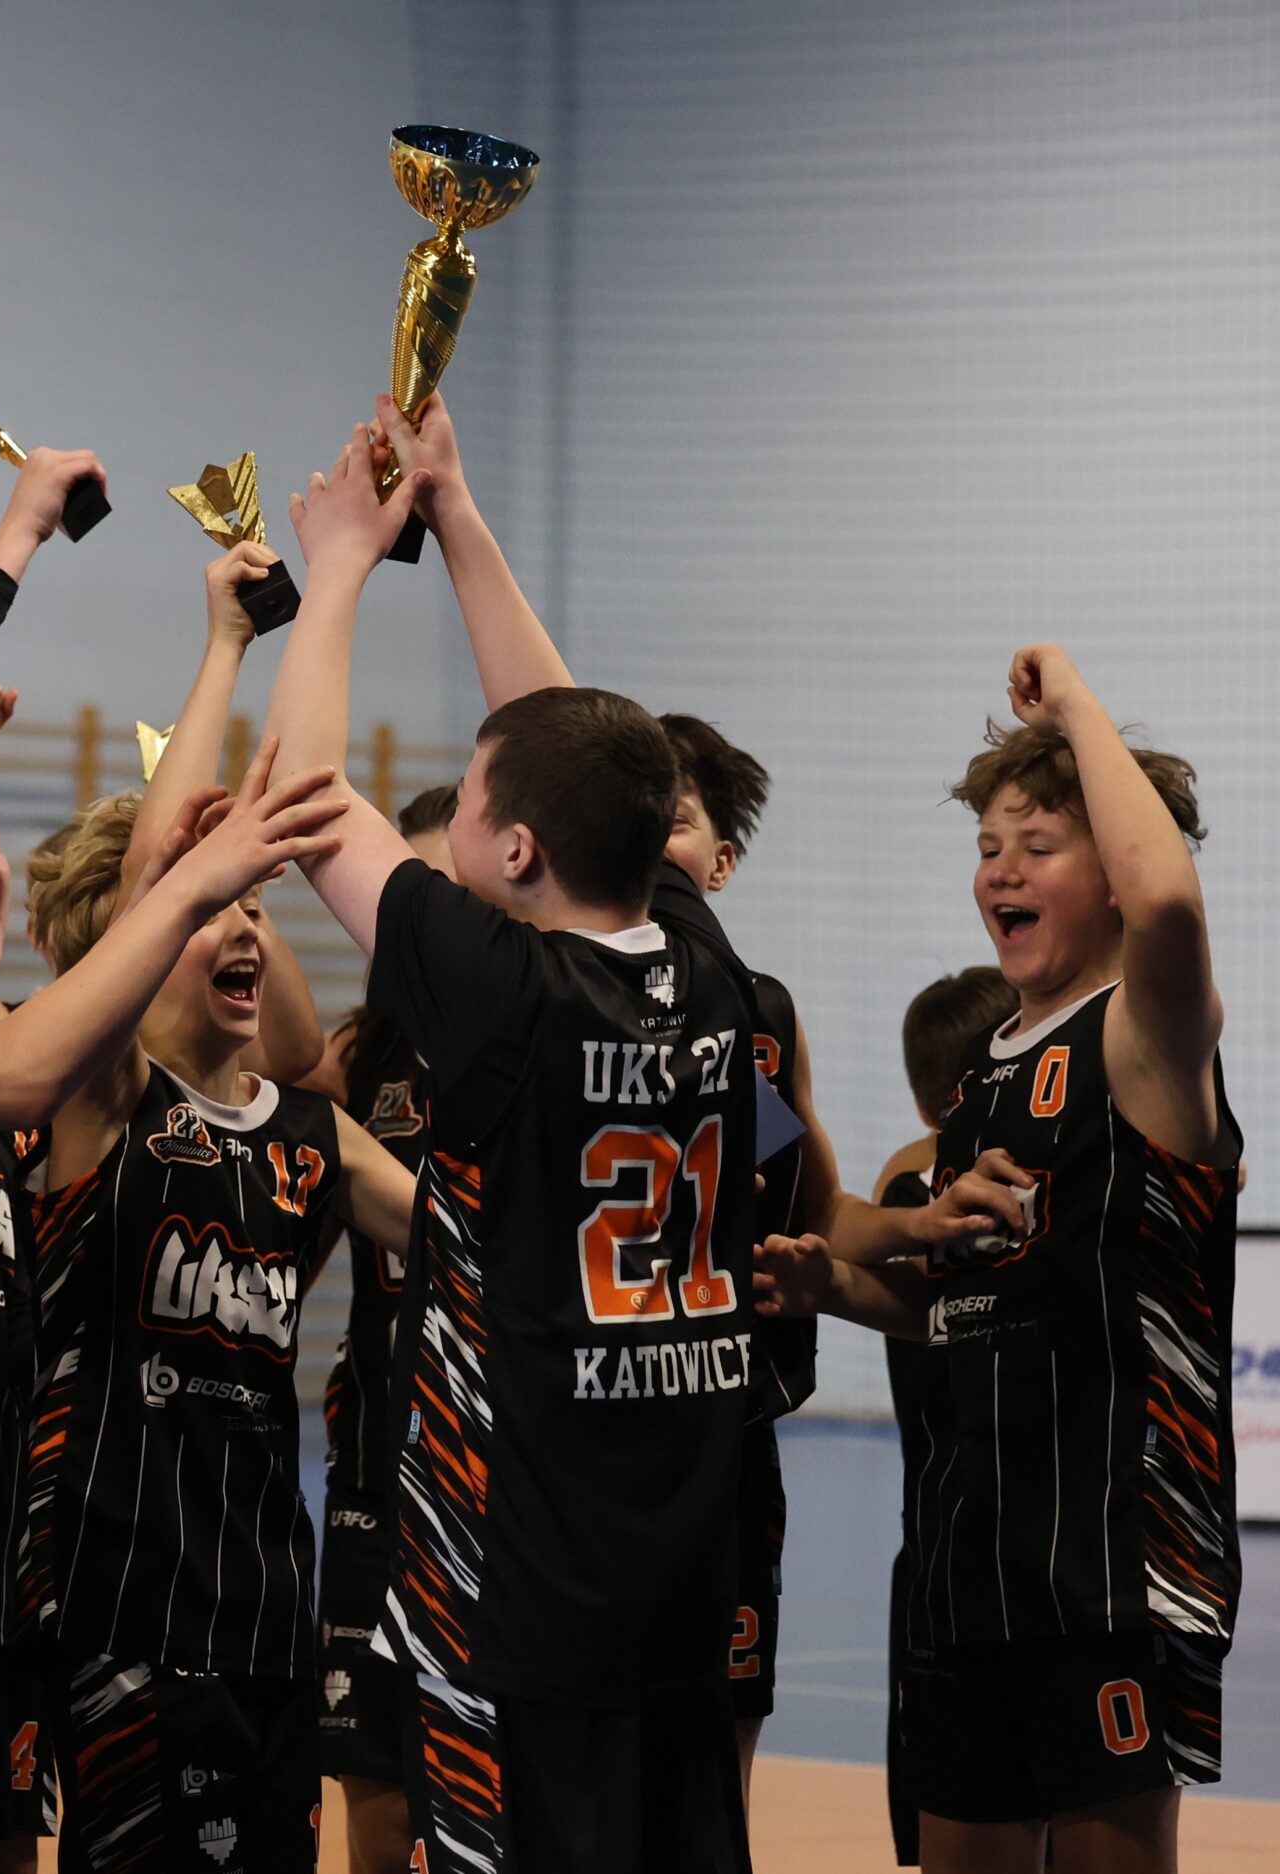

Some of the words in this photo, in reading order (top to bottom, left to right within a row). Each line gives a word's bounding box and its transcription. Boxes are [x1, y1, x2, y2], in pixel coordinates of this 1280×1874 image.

[582, 1040, 676, 1105] UKS
[691, 1028, 736, 1097] 27
[1029, 1045, 1071, 1118] 0
[577, 1113, 738, 1325] 21
[1097, 1677, 1150, 1756] 0
[9, 1720, 39, 1791] 4
